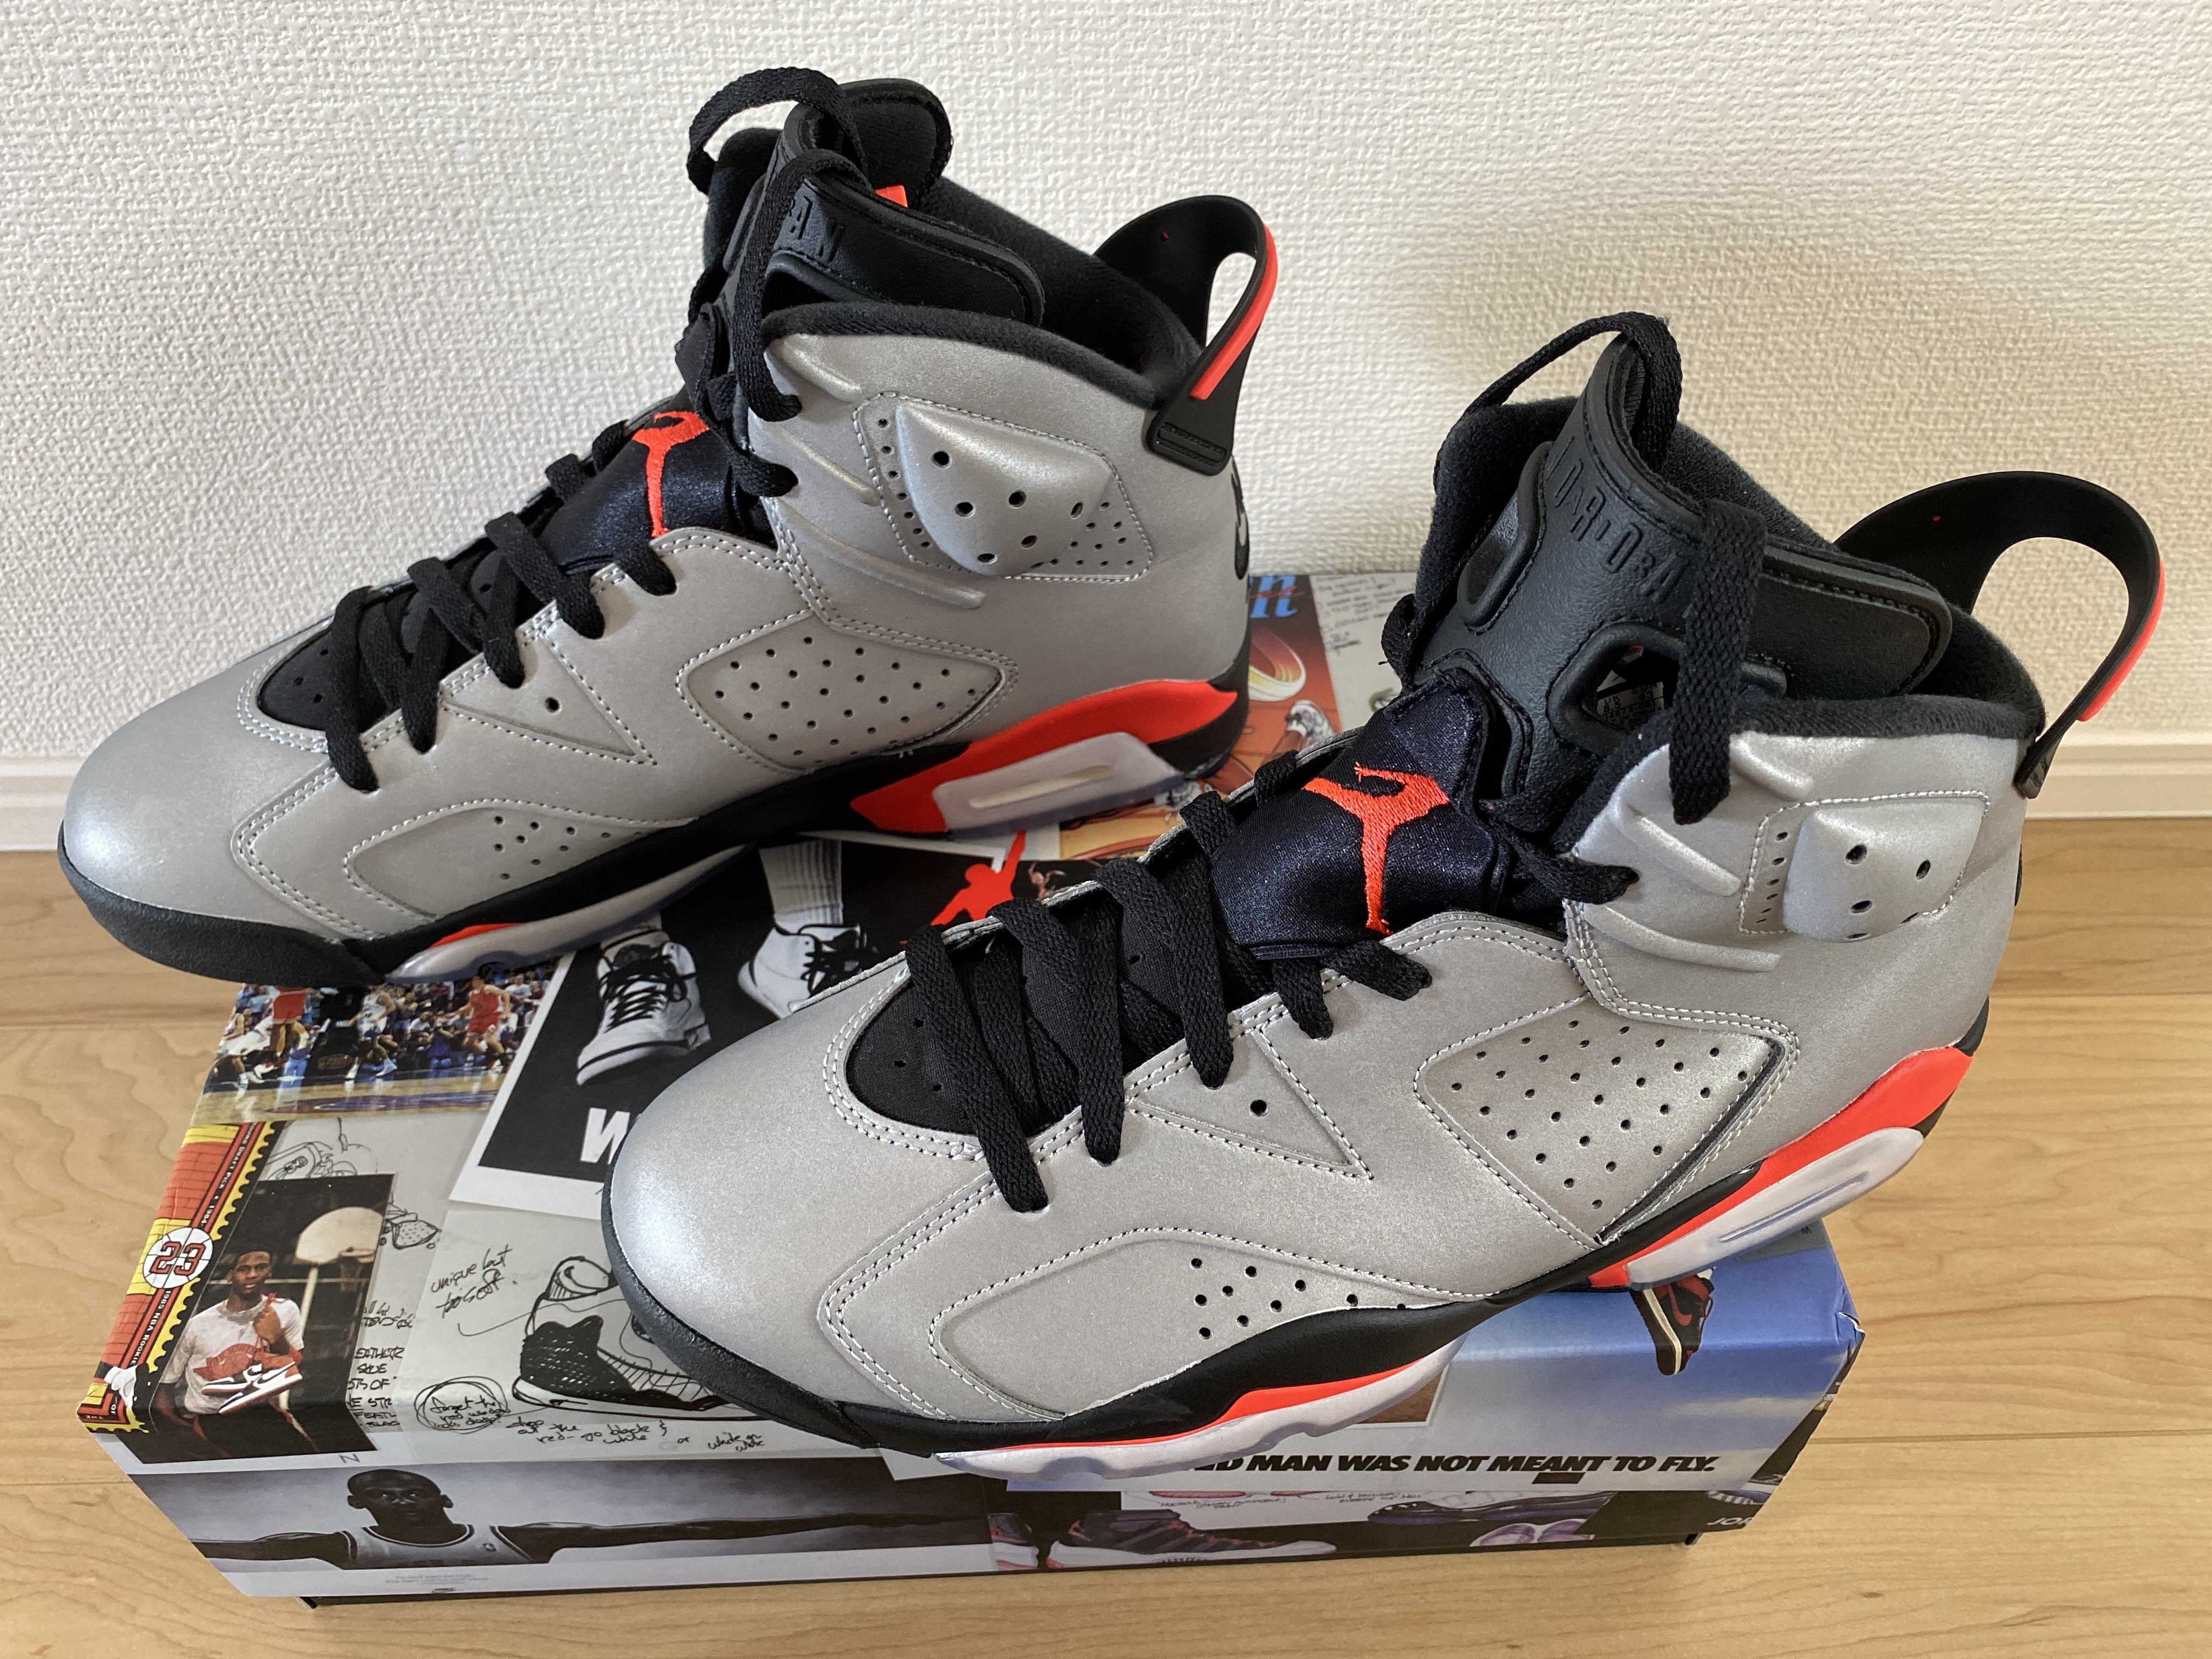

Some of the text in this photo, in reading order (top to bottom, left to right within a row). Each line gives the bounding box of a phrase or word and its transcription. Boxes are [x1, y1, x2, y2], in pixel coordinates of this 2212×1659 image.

[219, 1172, 232, 1189] PICK
[149, 1241, 206, 1277] 23
[146, 1312, 161, 1332] NBA
[129, 1334, 150, 1367] ROOKIE
[1245, 1455, 1333, 1471] MAN
[1338, 1455, 1412, 1471] WAS
[1413, 1455, 1491, 1471] NOT
[1486, 1455, 1612, 1471] MEANT
[1612, 1456, 1657, 1471] TO
[1657, 1456, 1722, 1471] FLY.
